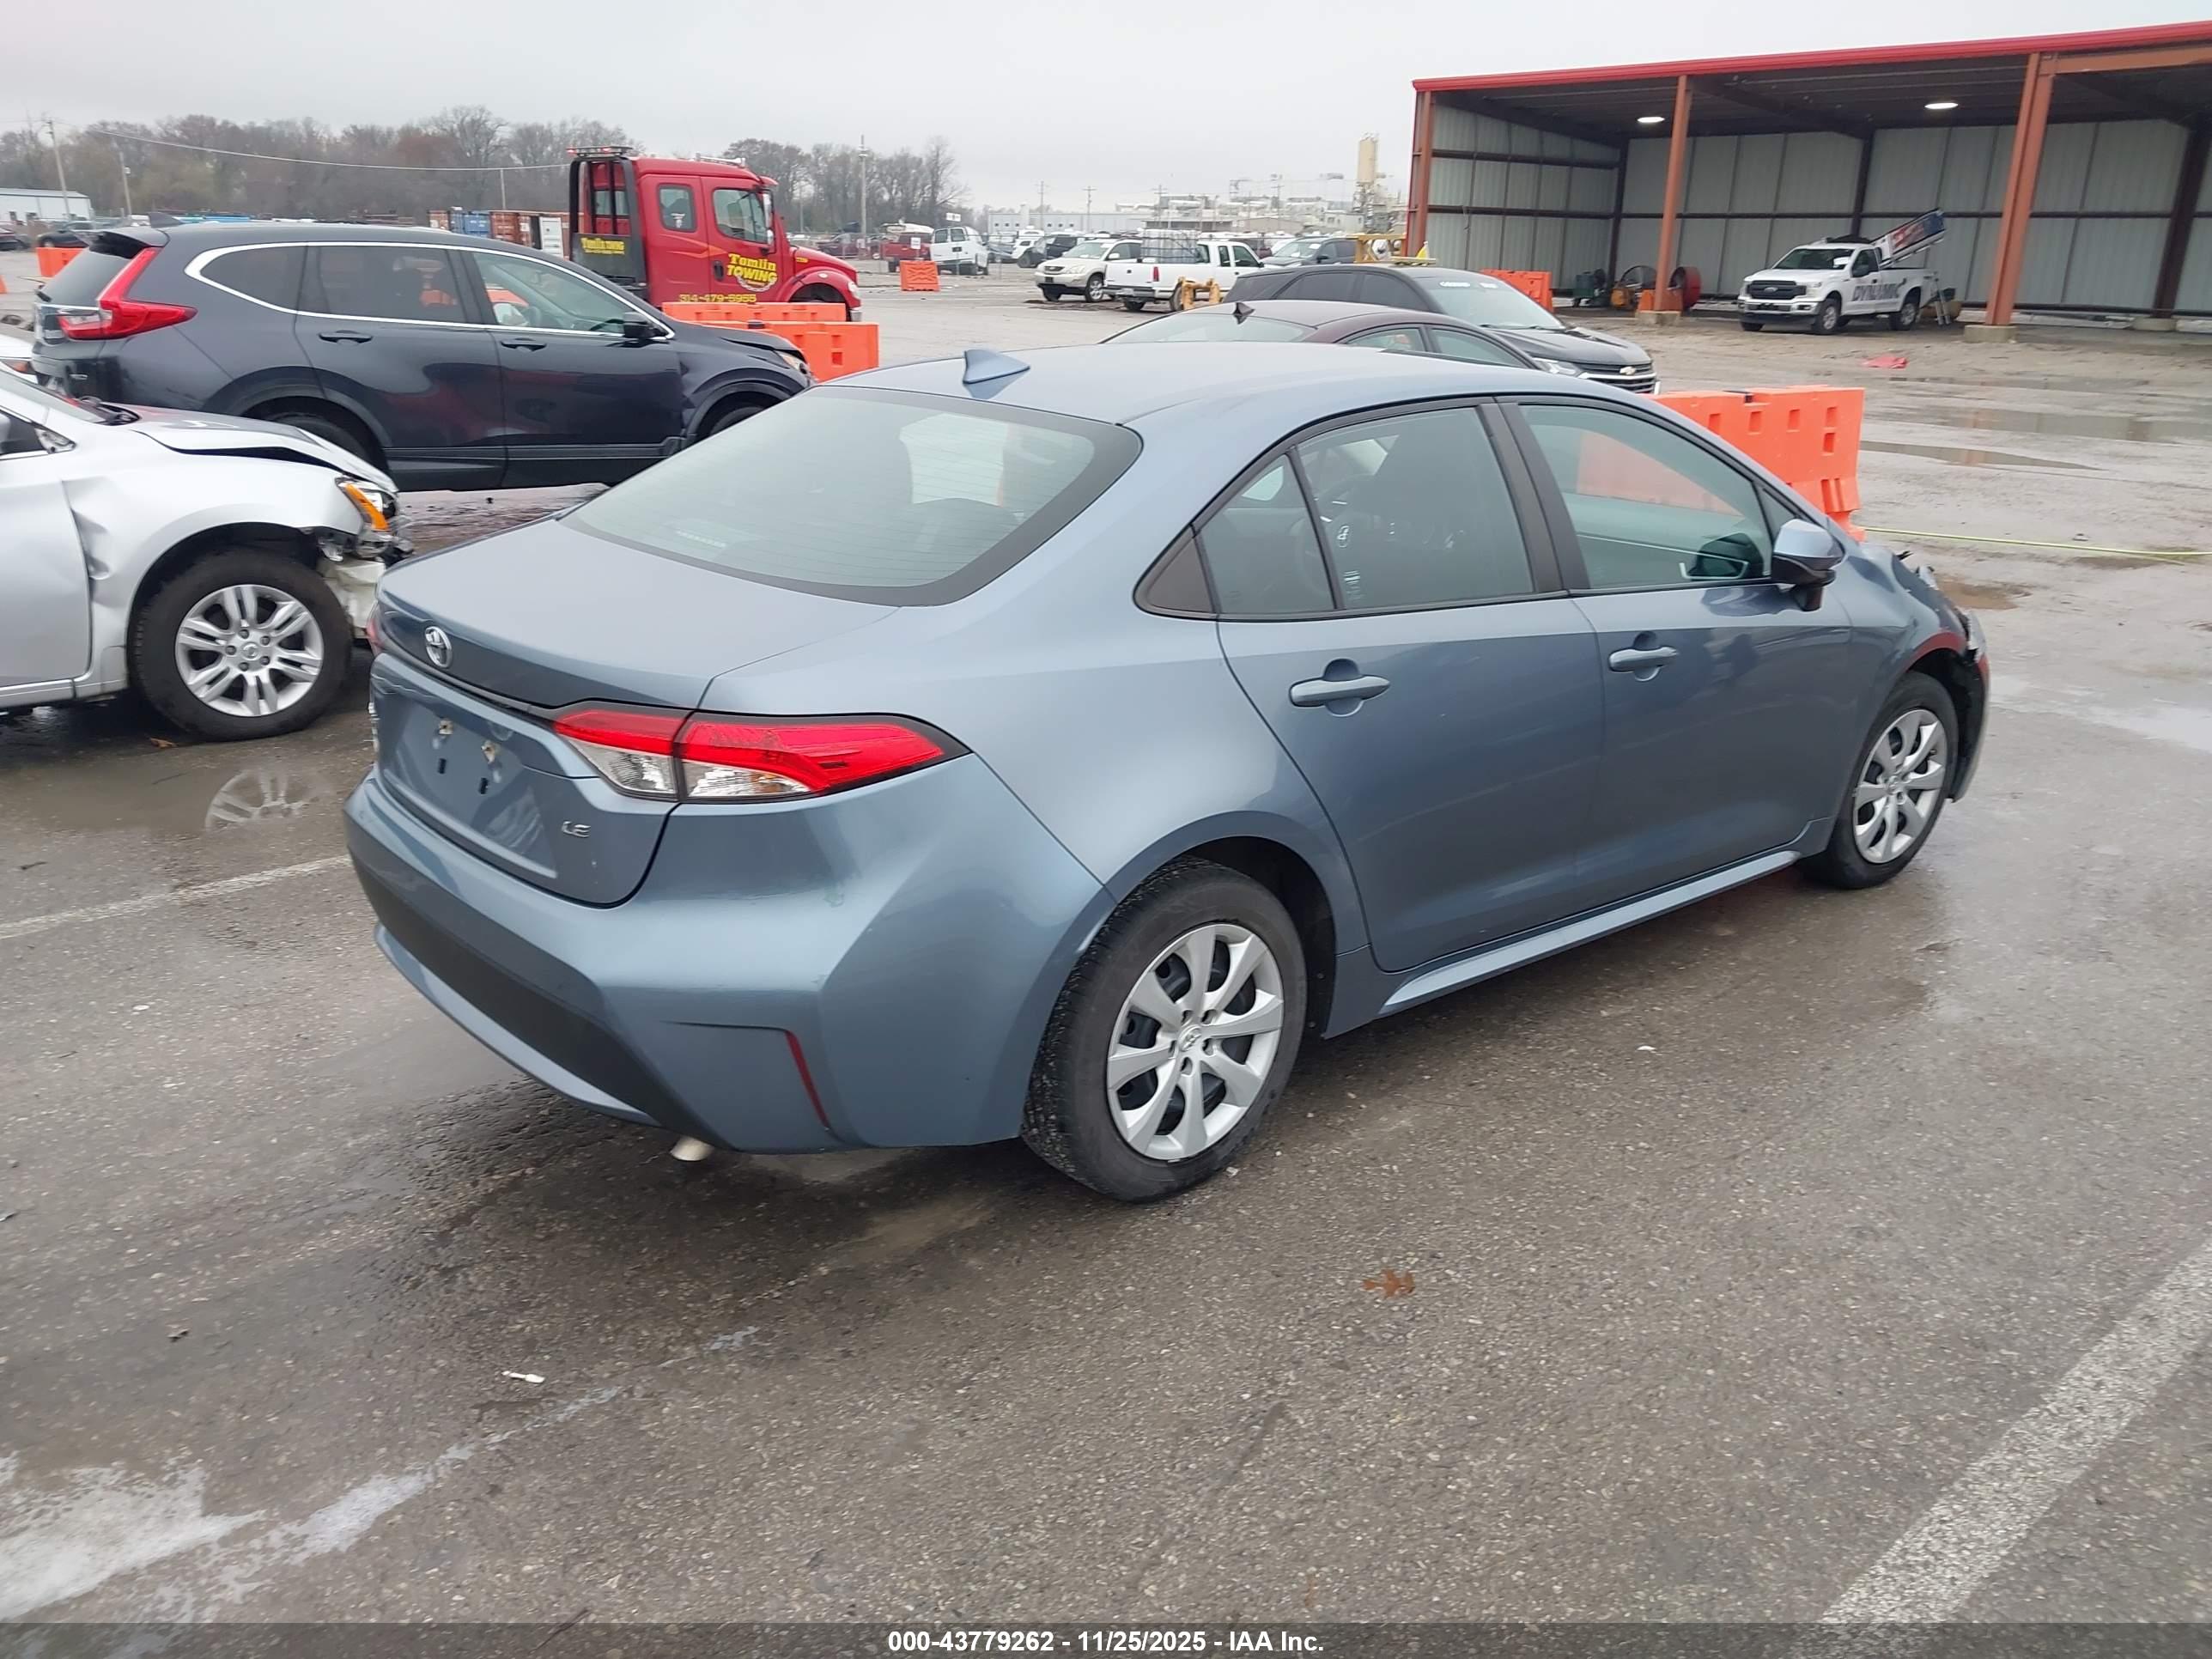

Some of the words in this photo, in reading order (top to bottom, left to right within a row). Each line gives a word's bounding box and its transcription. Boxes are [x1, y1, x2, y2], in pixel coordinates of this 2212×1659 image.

[728, 253, 776, 271] Tomlin
[726, 264, 778, 283] TOWING
[562, 821, 591, 837] LE
